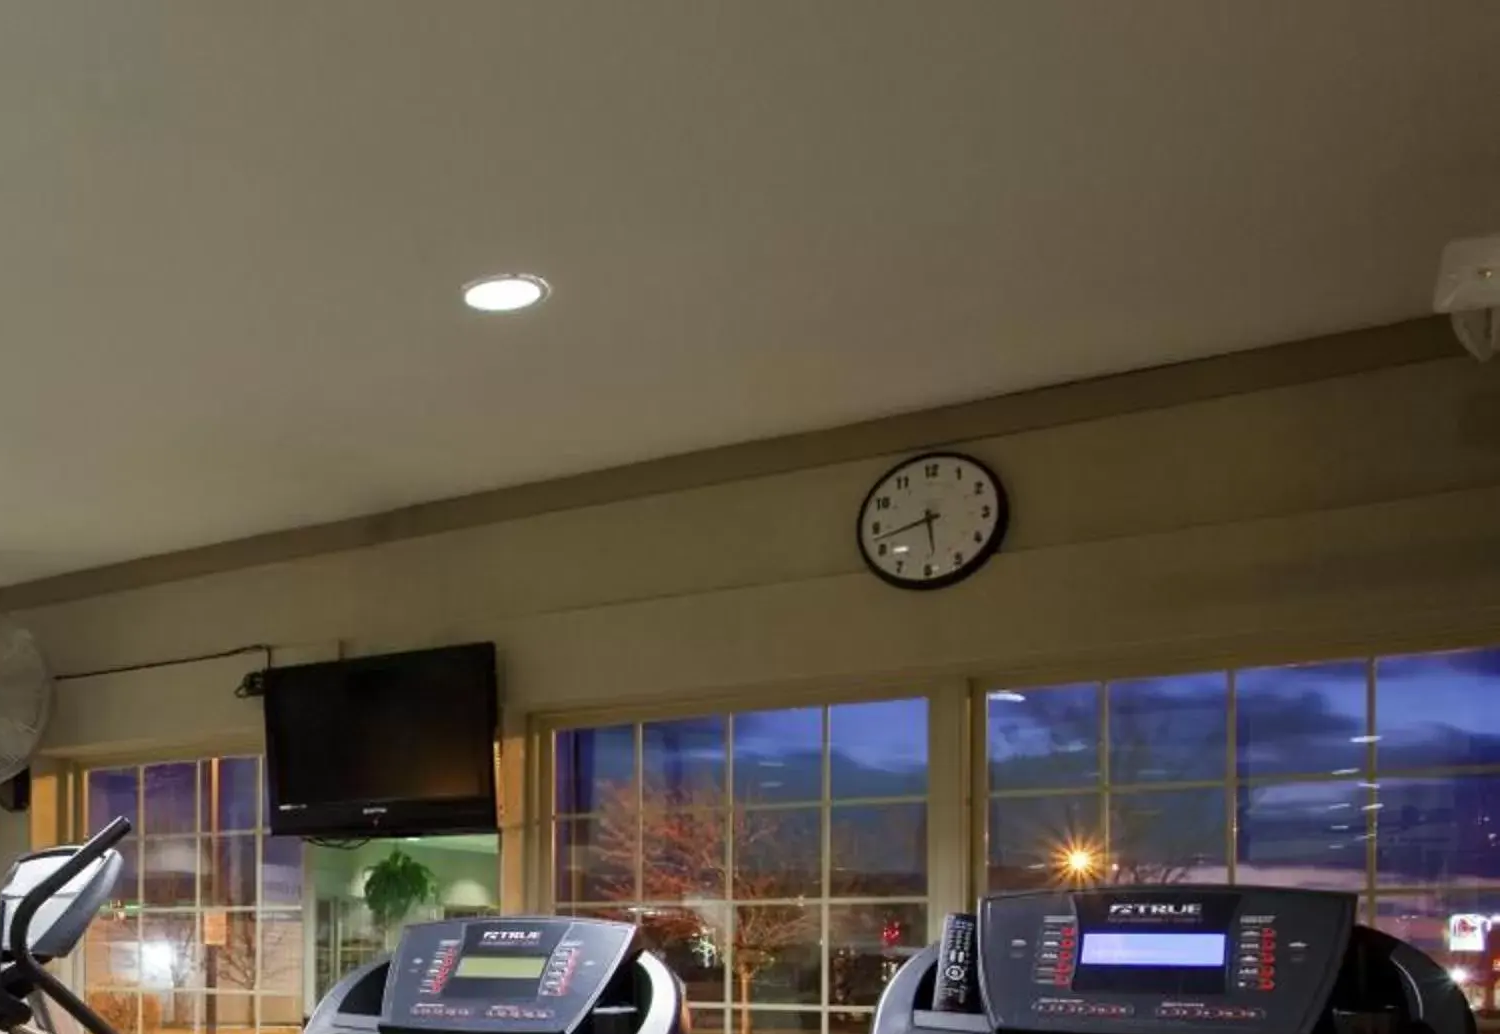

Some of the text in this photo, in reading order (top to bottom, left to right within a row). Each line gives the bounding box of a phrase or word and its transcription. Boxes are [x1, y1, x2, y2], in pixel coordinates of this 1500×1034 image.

[925, 464, 939, 479] 12
[956, 466, 962, 480] 1
[897, 476, 909, 491] 11
[975, 481, 984, 495] 2
[877, 497, 890, 511] 10
[981, 505, 990, 519] 3
[897, 561, 904, 574] 7
[1135, 903, 1202, 914] TRUE
